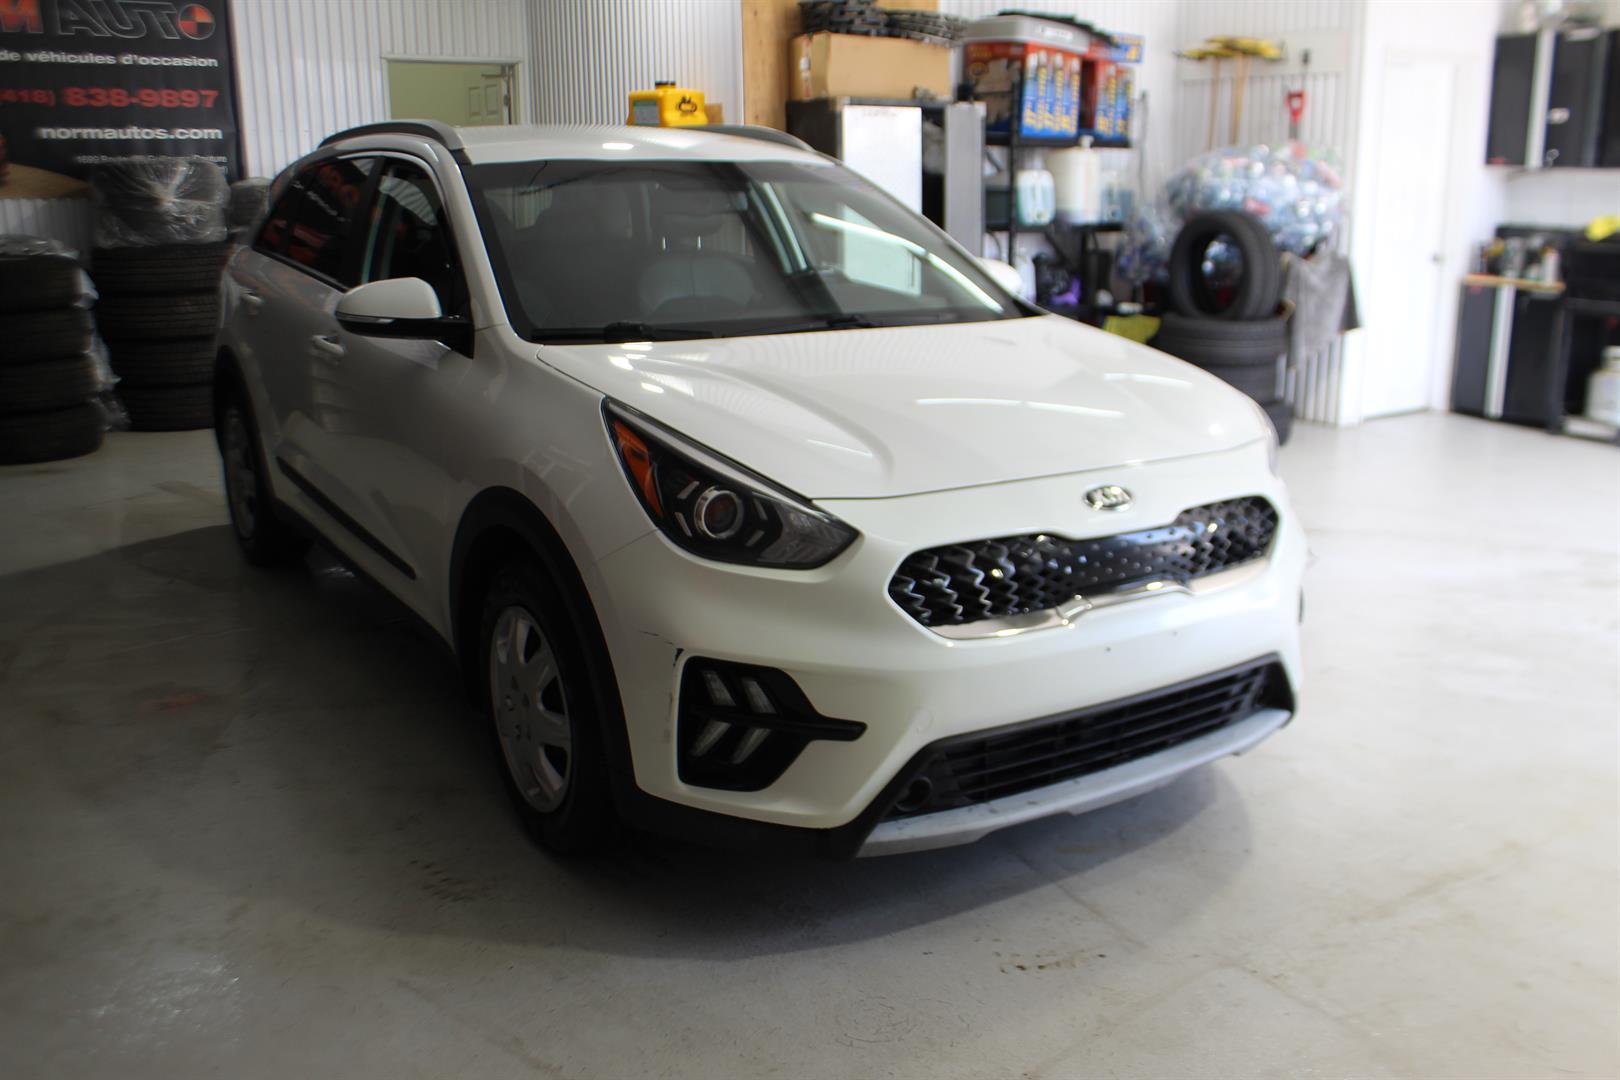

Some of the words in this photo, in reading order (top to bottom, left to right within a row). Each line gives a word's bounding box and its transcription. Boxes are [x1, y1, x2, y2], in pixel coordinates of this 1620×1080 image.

[0, 50, 21, 62] de
[25, 50, 117, 65] véhicules
[121, 54, 219, 68] d'occasion
[63, 86, 219, 108] 838-9897
[38, 126, 224, 141] normautos.com
